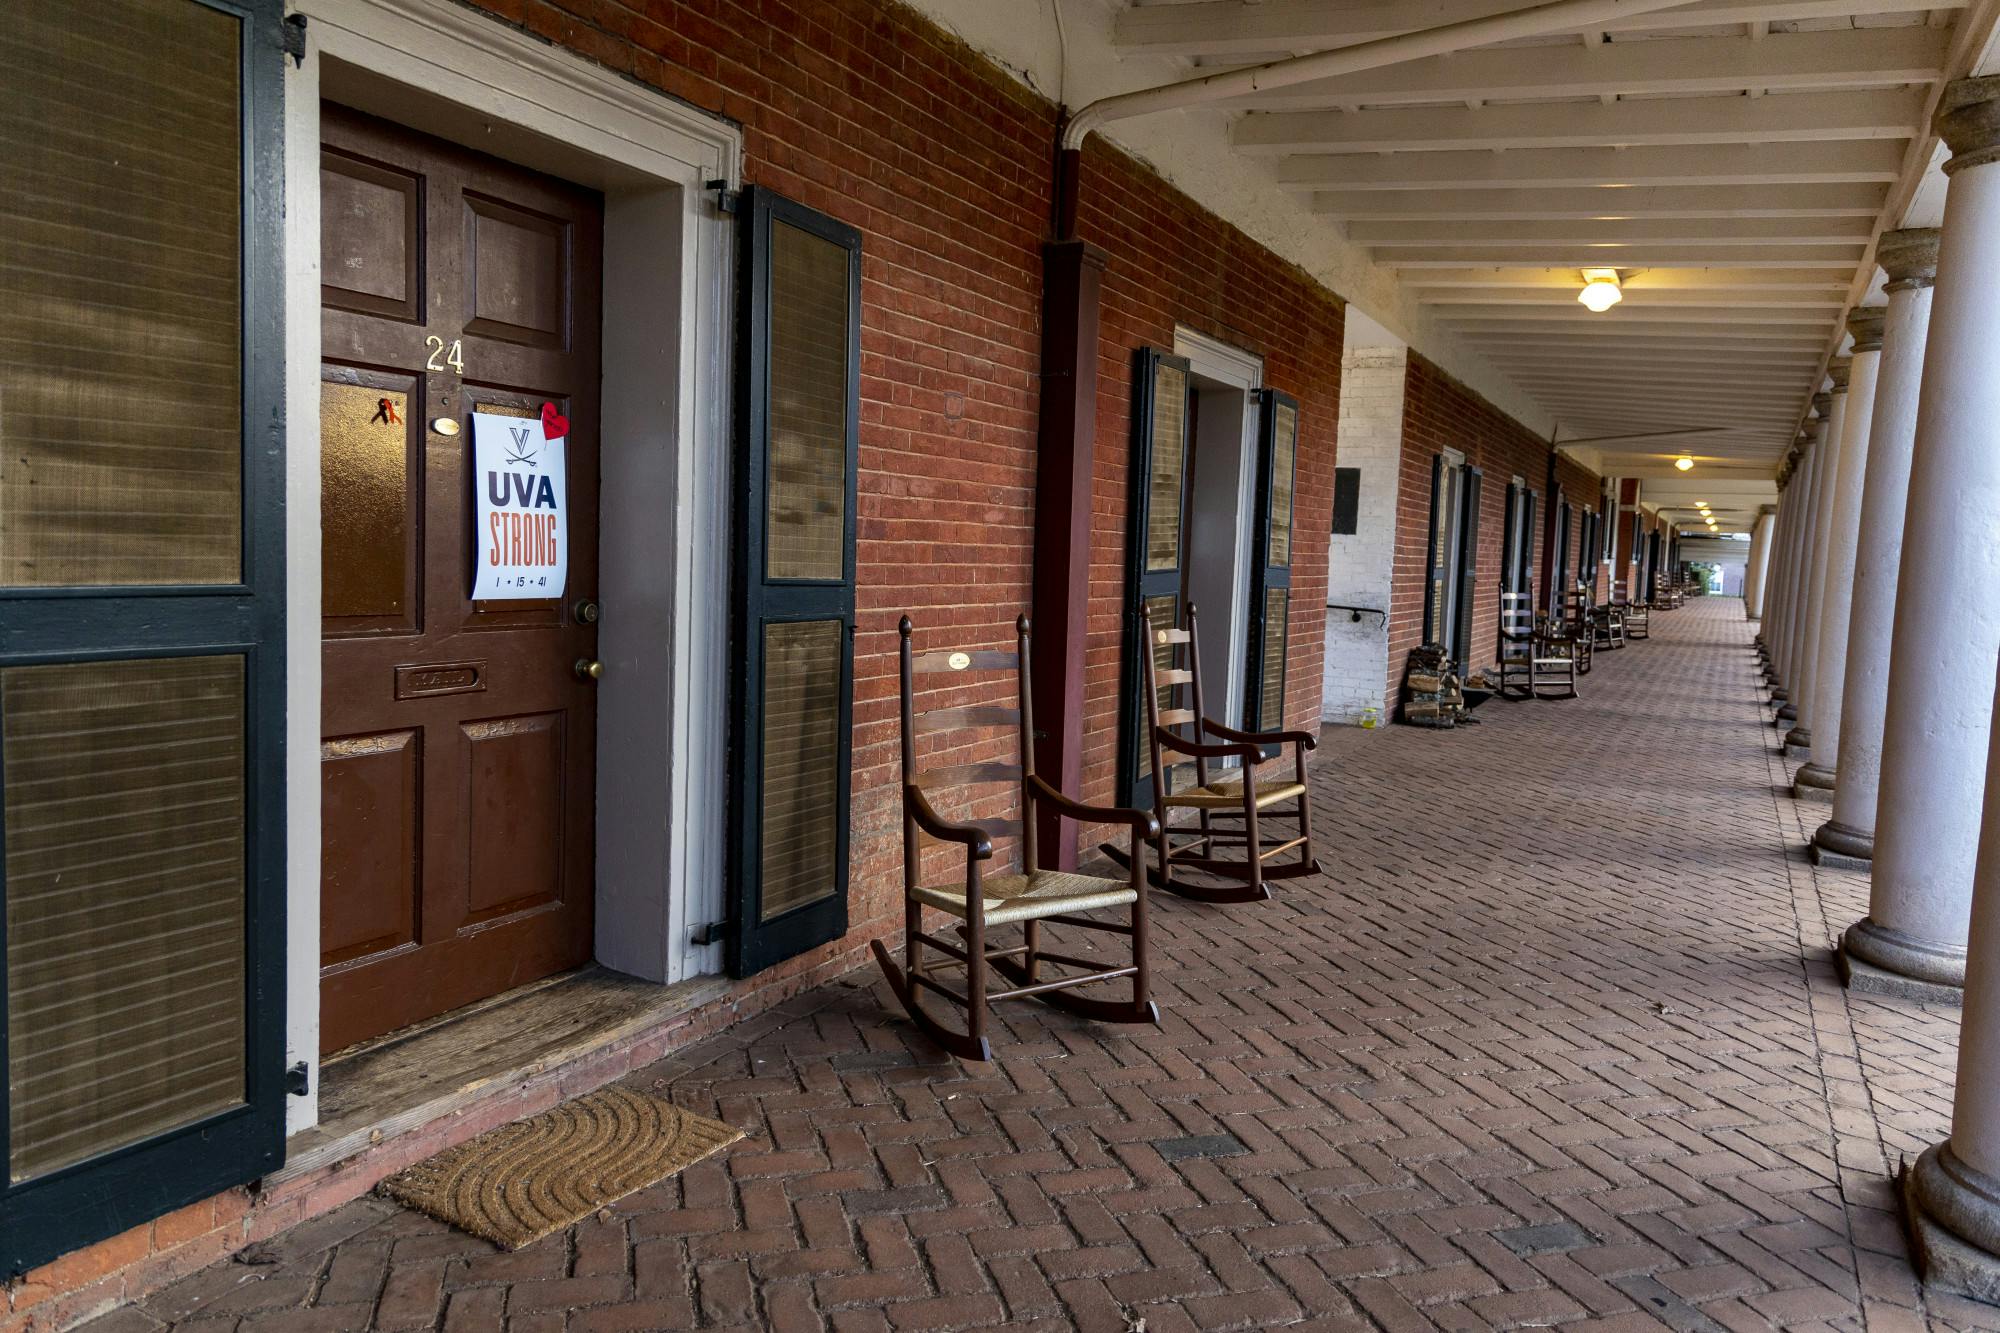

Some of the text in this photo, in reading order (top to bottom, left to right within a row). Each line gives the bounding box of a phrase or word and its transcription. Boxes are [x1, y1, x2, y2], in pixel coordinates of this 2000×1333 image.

[425, 336, 464, 374] 24
[488, 470, 557, 509] UVA
[489, 511, 557, 567] STRONG
